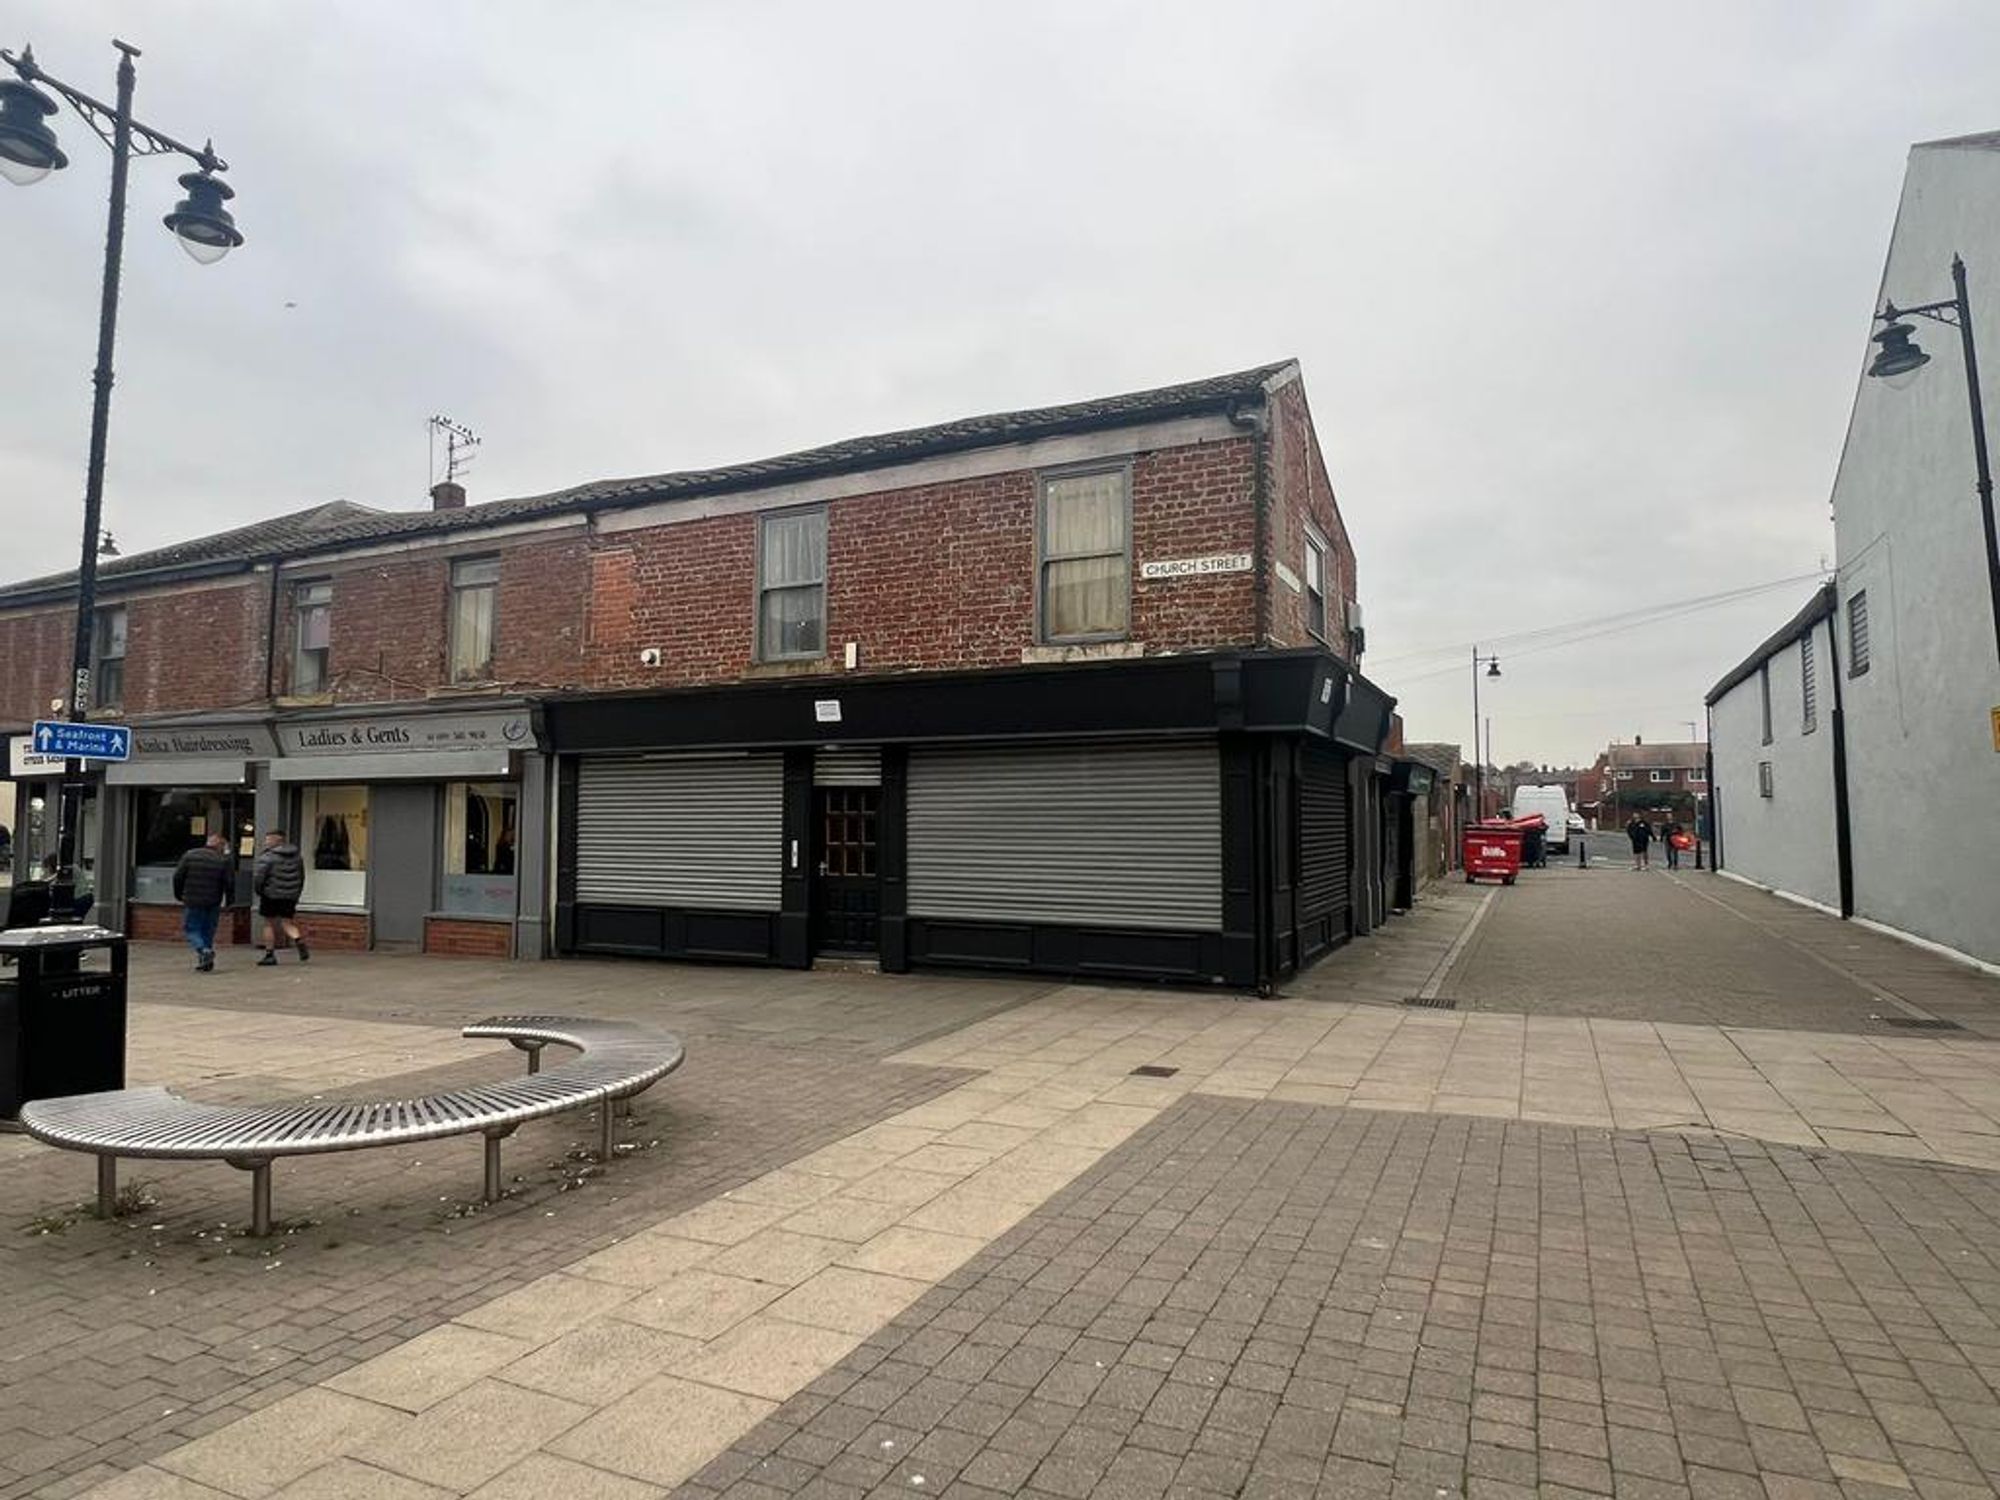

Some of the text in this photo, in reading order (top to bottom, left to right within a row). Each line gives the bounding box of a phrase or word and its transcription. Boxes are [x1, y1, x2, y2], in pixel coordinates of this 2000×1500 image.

[1146, 556, 1247, 576] CHURCH STREET
[56, 728, 107, 740] Seafront
[298, 727, 348, 747] Ladies
[351, 727, 363, 744] &
[366, 727, 410, 744] Gents
[55, 739, 106, 752] & Marina
[171, 734, 254, 756] Hairdressing
[61, 985, 101, 998] LITTER
